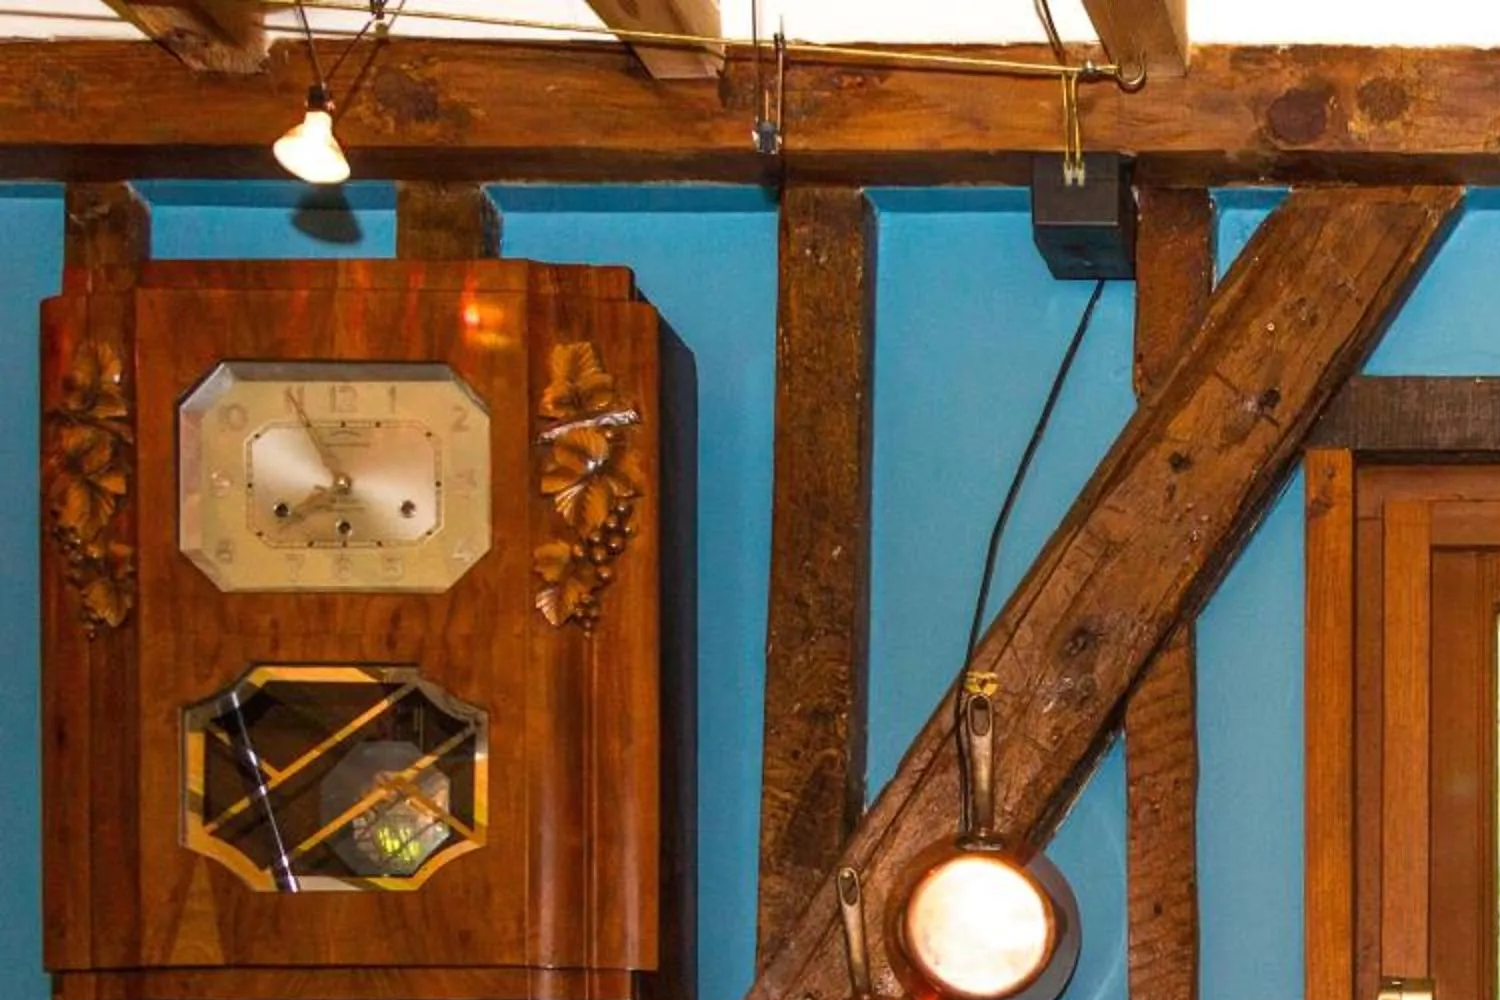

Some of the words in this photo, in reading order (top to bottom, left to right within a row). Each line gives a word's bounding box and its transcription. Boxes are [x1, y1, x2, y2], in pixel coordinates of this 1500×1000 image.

[329, 385, 357, 413] 12
[388, 386, 397, 413] 1
[450, 405, 471, 432] 2
